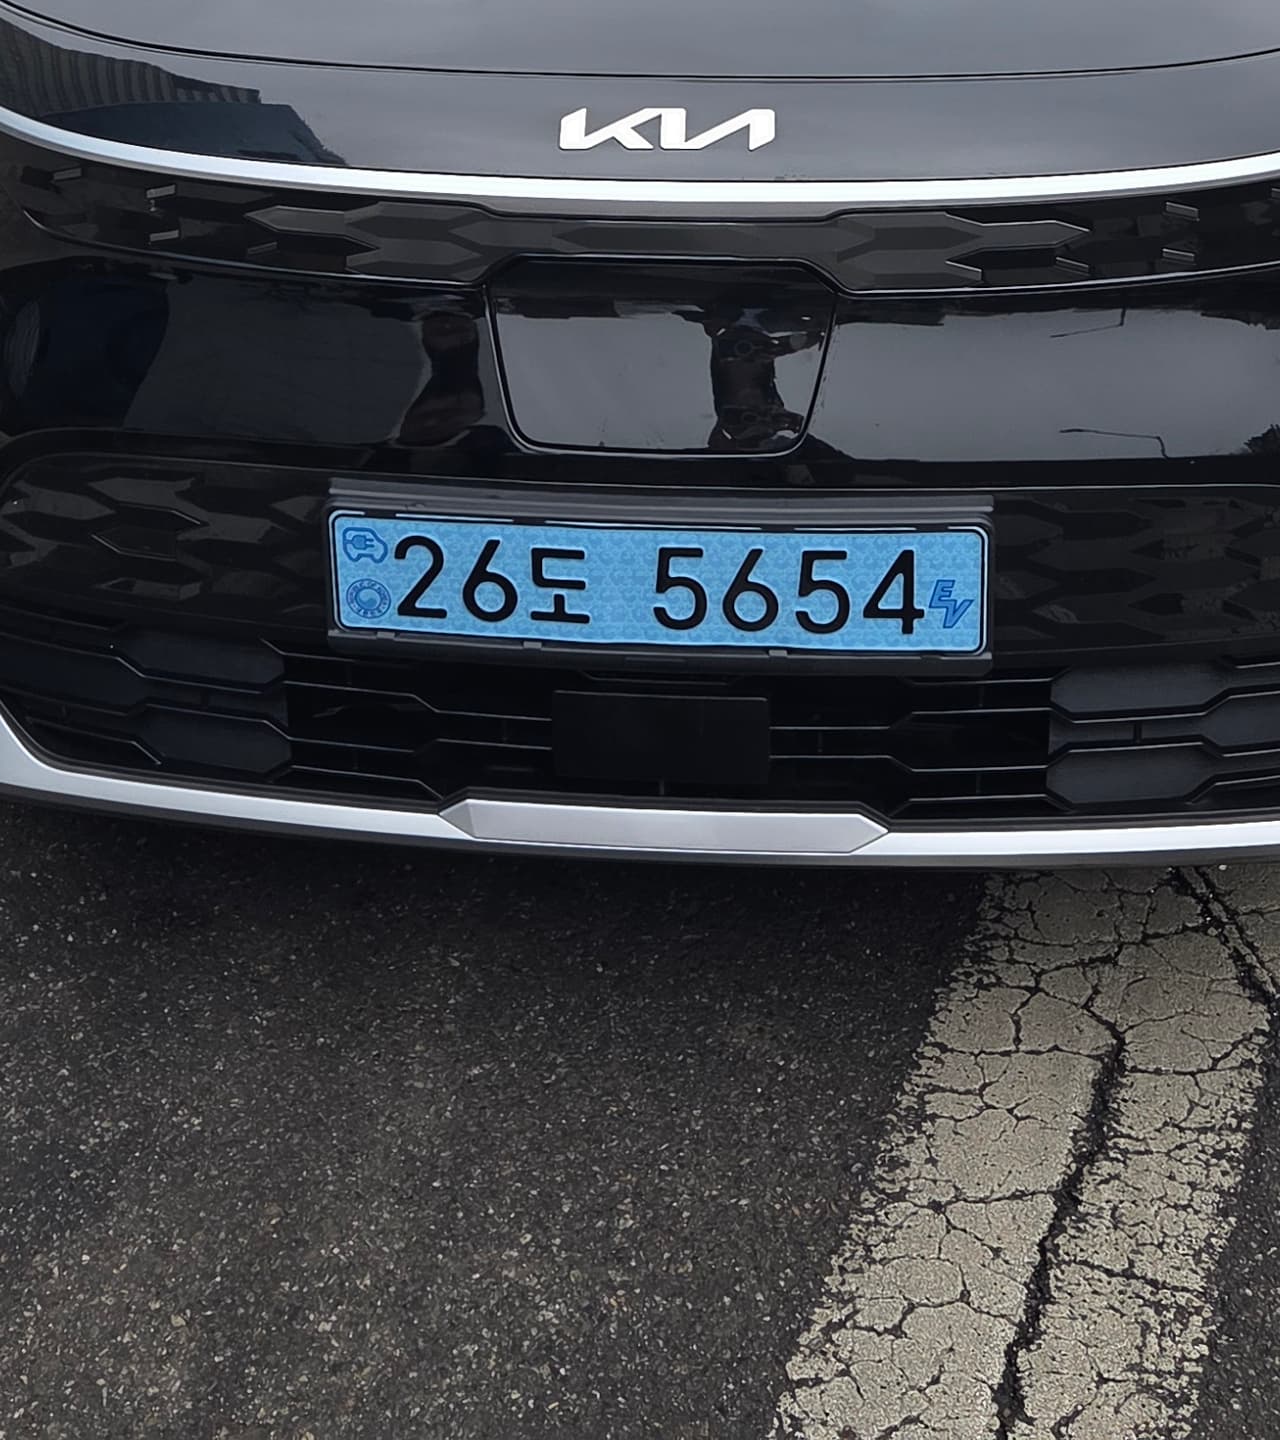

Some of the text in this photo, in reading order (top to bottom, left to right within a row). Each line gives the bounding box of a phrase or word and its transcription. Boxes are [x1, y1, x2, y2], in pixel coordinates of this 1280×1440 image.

[558, 107, 776, 151] KIA
[393, 534, 591, 625] 26도
[652, 545, 926, 635] 5654
[928, 579, 976, 629] EV
